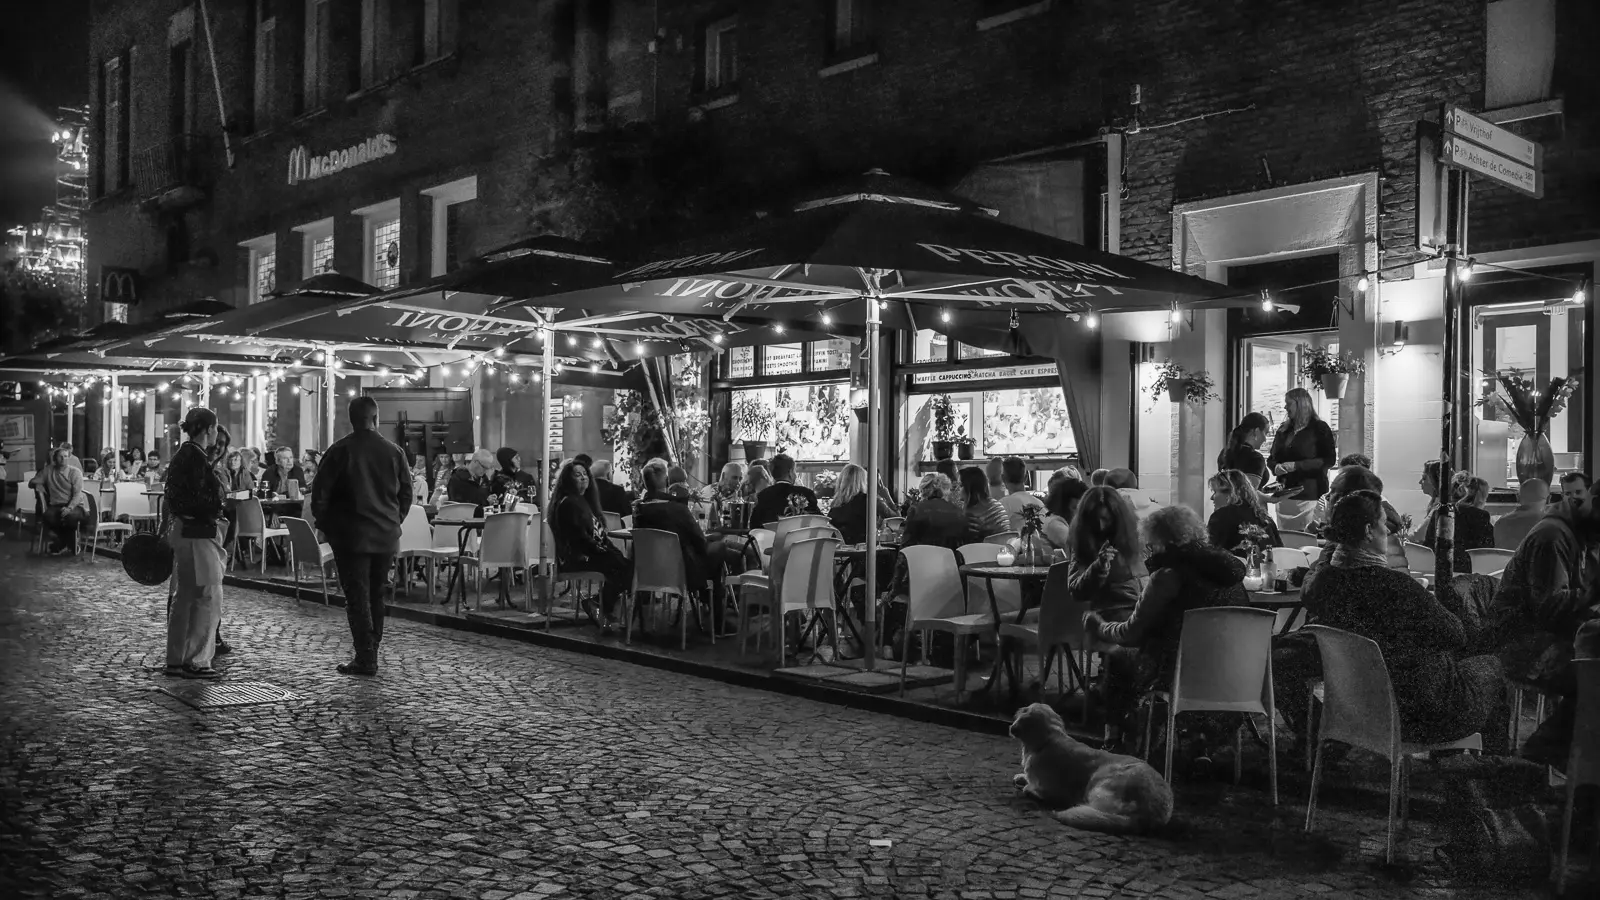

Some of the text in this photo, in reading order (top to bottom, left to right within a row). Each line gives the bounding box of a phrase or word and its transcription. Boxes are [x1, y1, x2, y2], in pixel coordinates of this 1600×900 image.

[1455, 115, 1461, 126] P
[1469, 121, 1493, 141] Vrijthof
[309, 133, 397, 180] McDonald's
[1454, 144, 1460, 156] P
[1468, 152, 1489, 168] Achter
[1489, 160, 1497, 172] de
[1498, 163, 1523, 182] Comedie
[916, 242, 1136, 280] PERONI
[938, 373, 972, 381] CAPPUCCINO
[974, 371, 996, 379] MATCHA
[1020, 368, 1035, 376] CAKE
